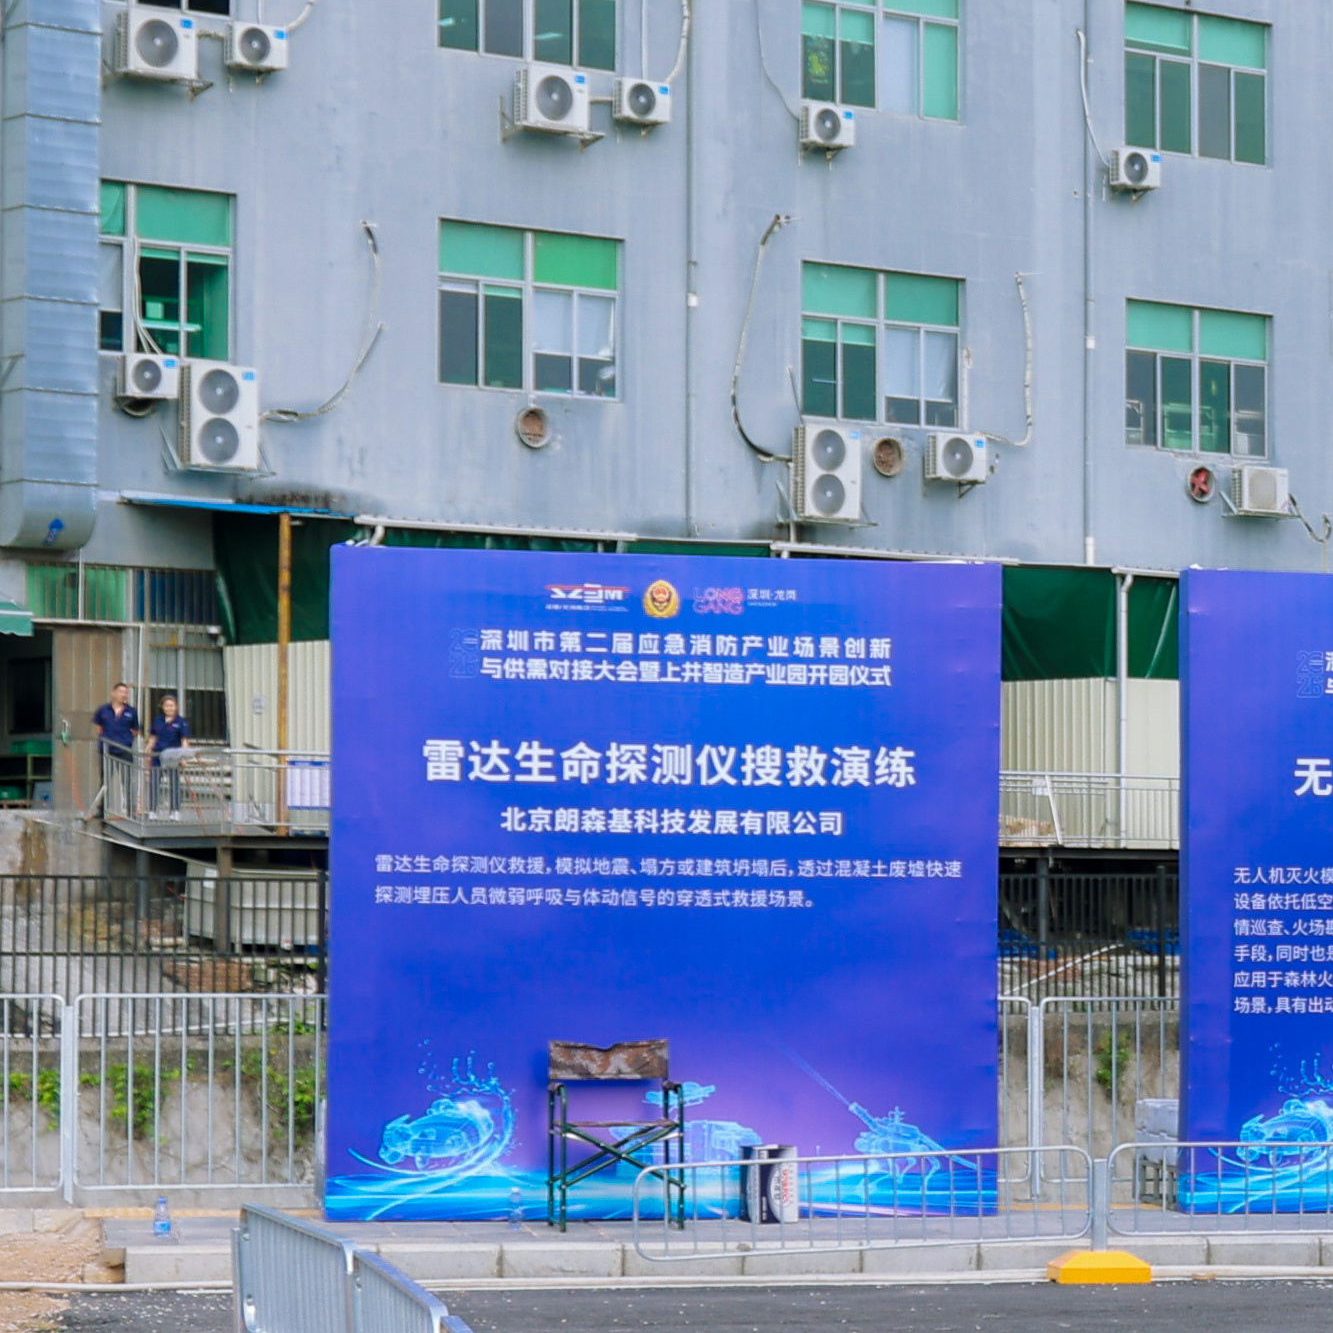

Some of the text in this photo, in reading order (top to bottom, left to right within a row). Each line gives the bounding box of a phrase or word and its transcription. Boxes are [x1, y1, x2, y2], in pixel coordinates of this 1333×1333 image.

[692, 600, 743, 615] GANG
[693, 587, 743, 601] LONG
[480, 628, 891, 659] 深圳市第二届应急消防产业场景创新
[480, 657, 891, 687] 与供需对接大会暨上井智造产业园开园仪式
[422, 738, 917, 788] 雷达生命探测仪搜救演练
[500, 805, 843, 836] 北京朗森基科技发展有限公司
